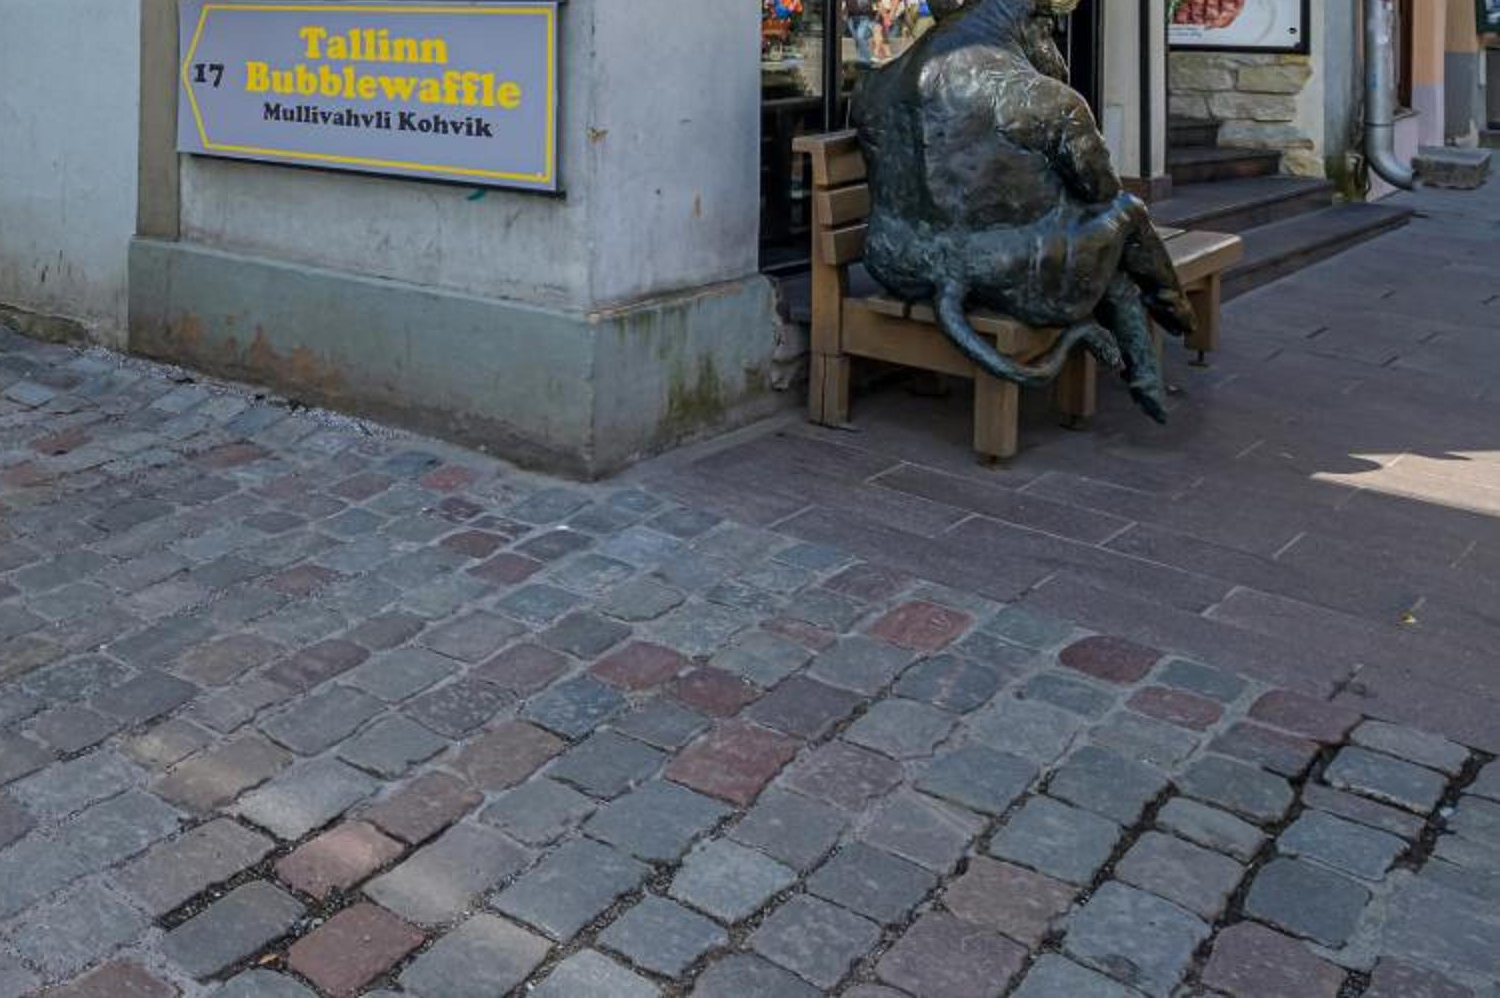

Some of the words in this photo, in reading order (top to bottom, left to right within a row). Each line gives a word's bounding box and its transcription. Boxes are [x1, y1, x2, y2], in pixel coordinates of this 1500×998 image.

[299, 25, 449, 64] Tallinn
[193, 62, 225, 88] 17
[245, 61, 523, 110] Bubblewaffle
[263, 102, 392, 130] Mullivahvli
[398, 111, 494, 138] Kohvik
